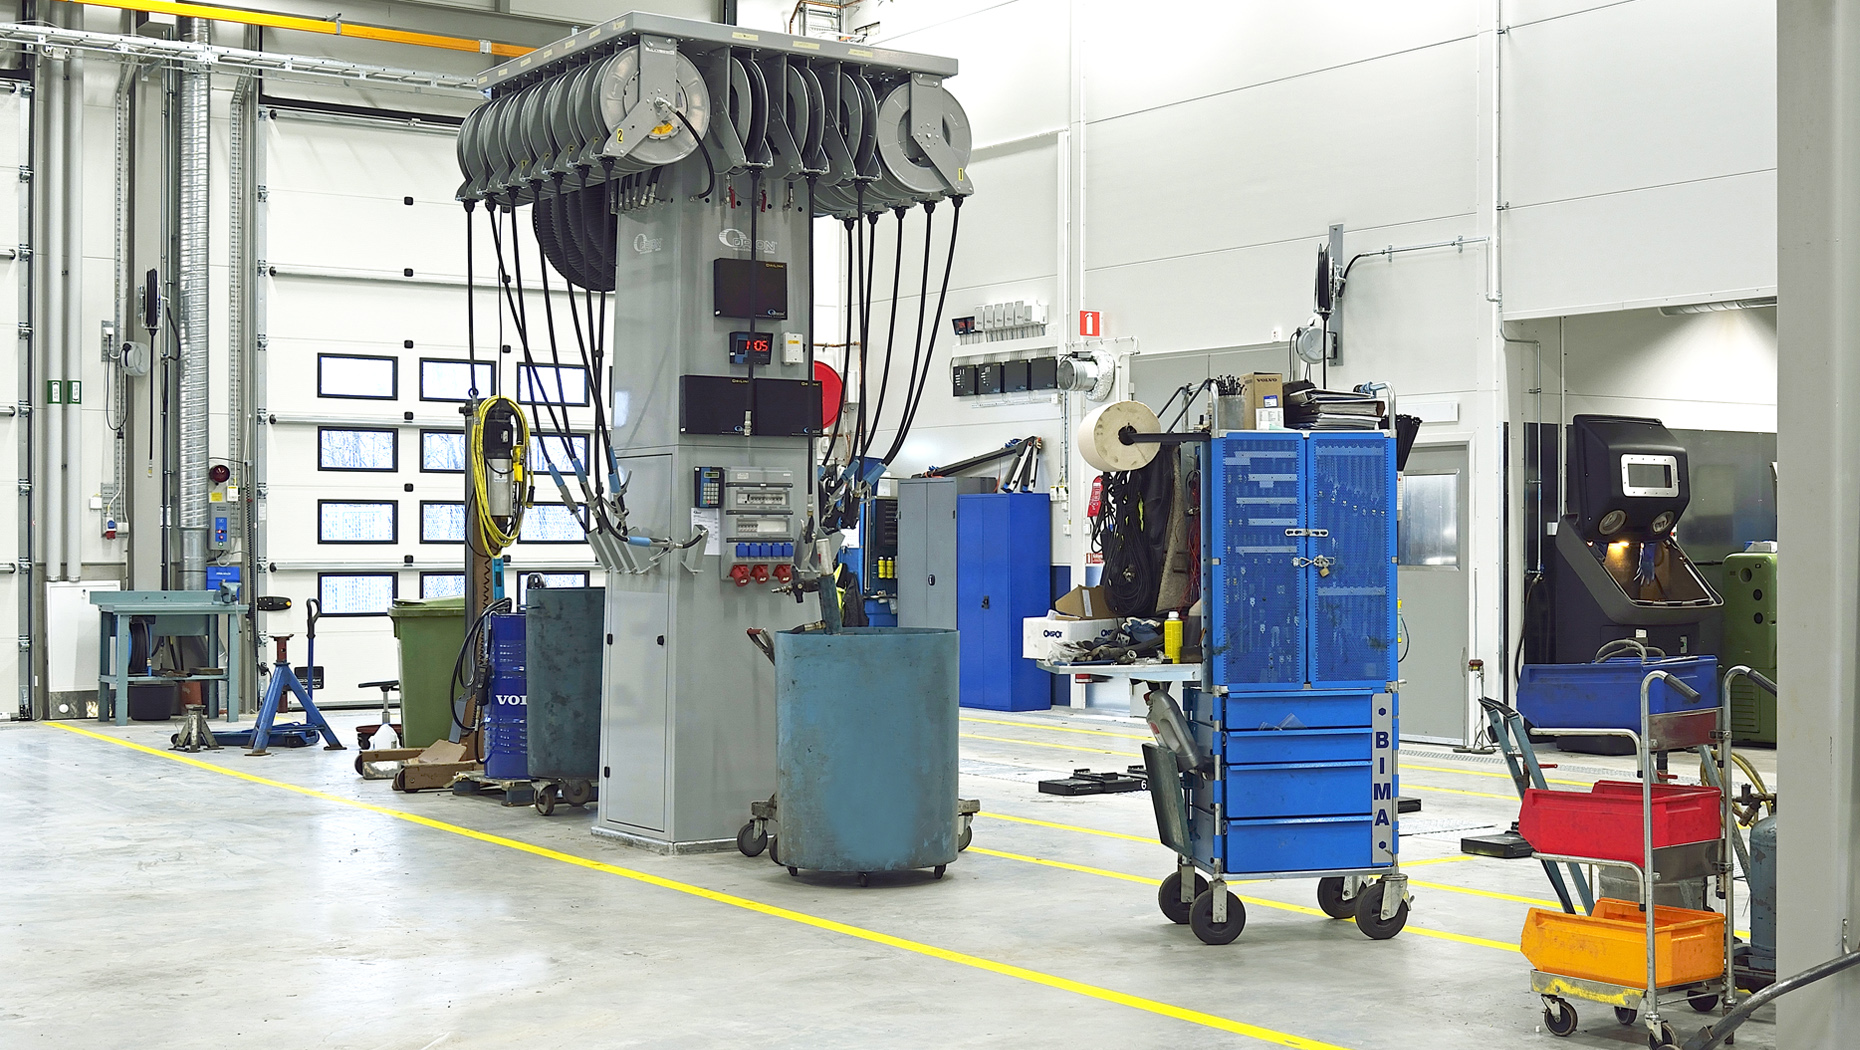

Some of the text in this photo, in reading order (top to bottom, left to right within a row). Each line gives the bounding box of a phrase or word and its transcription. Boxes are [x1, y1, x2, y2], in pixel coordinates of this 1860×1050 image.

[618, 130, 623, 142] 2
[1374, 731, 1391, 826] BIMA
[1141, 780, 1147, 790] 6
